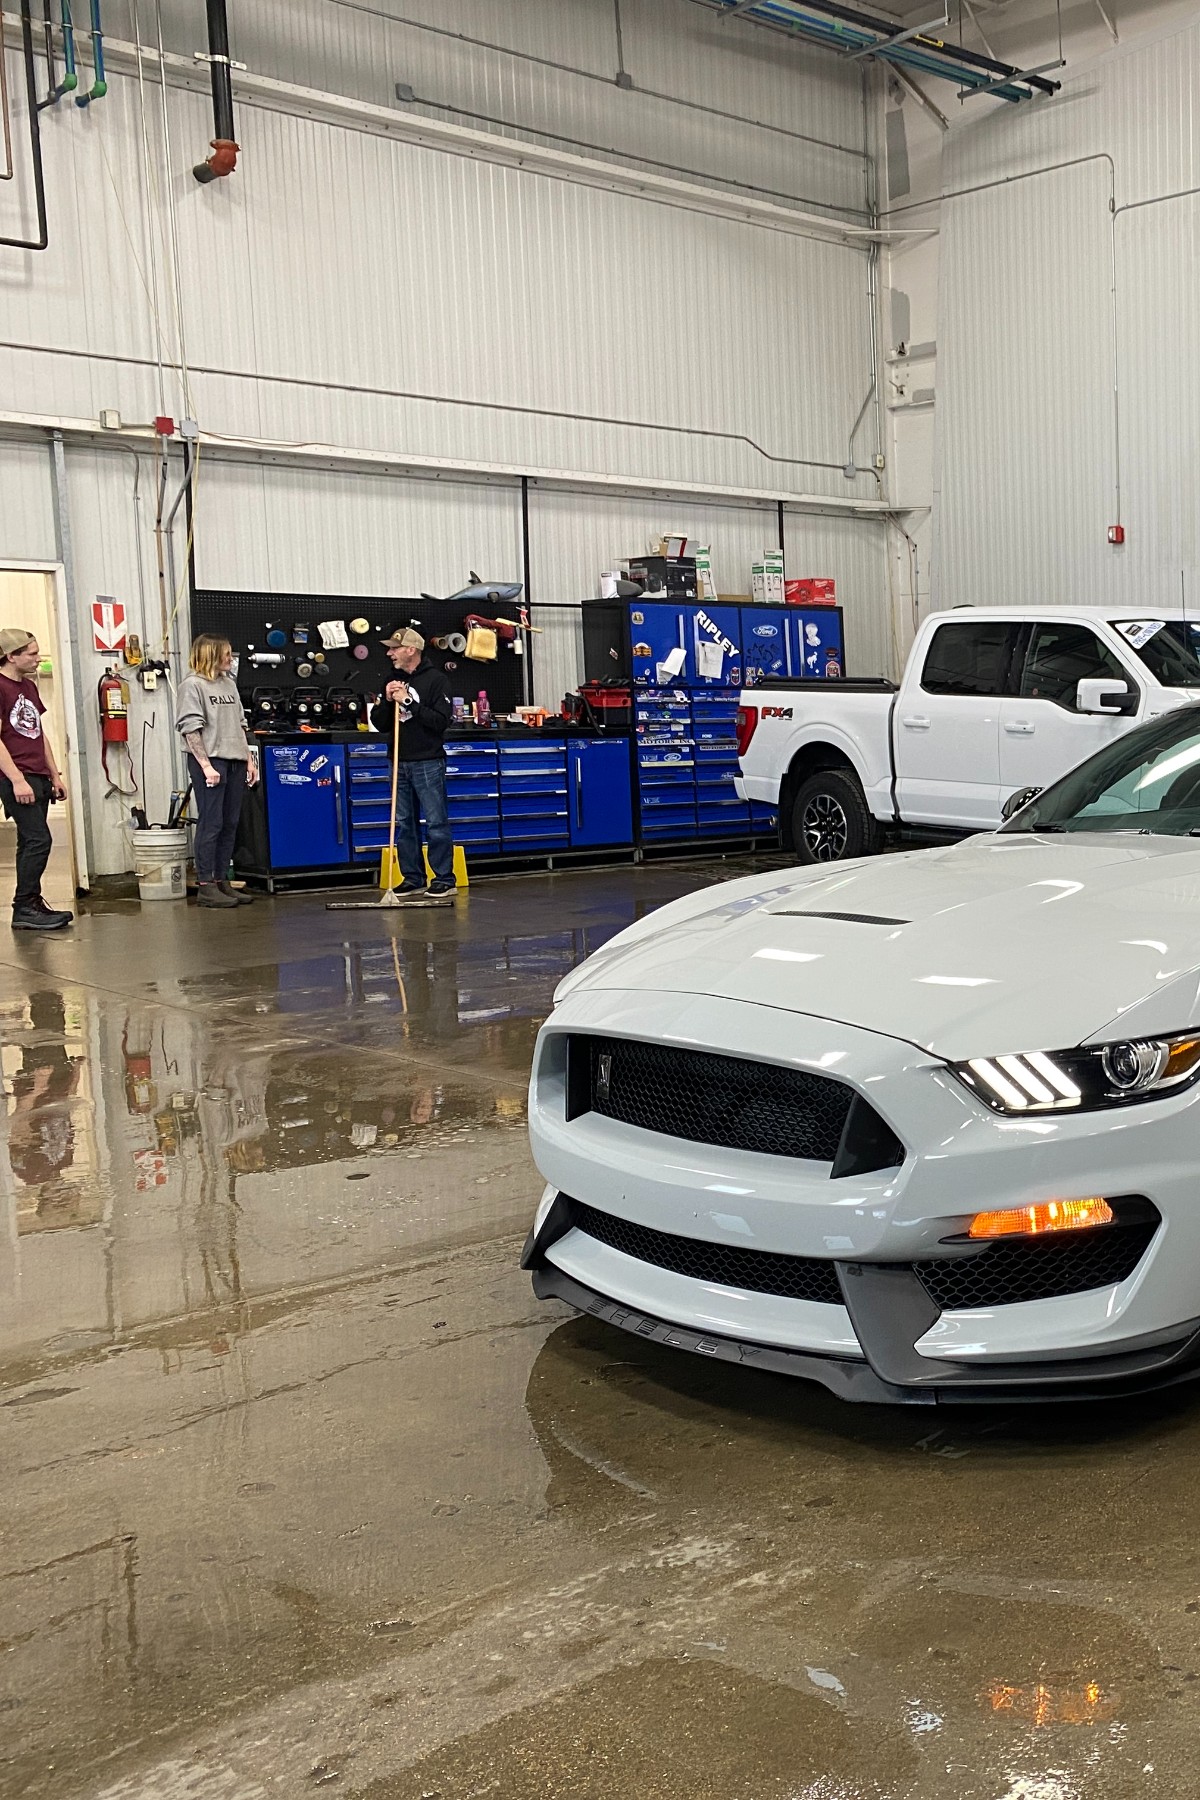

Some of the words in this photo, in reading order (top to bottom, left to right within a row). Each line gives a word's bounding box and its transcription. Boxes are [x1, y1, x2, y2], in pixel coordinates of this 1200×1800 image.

[696, 609, 740, 659] RIPLEY
[755, 625, 775, 636] Ford
[761, 706, 794, 720] FX4
[586, 1298, 762, 1362] SHELBY
